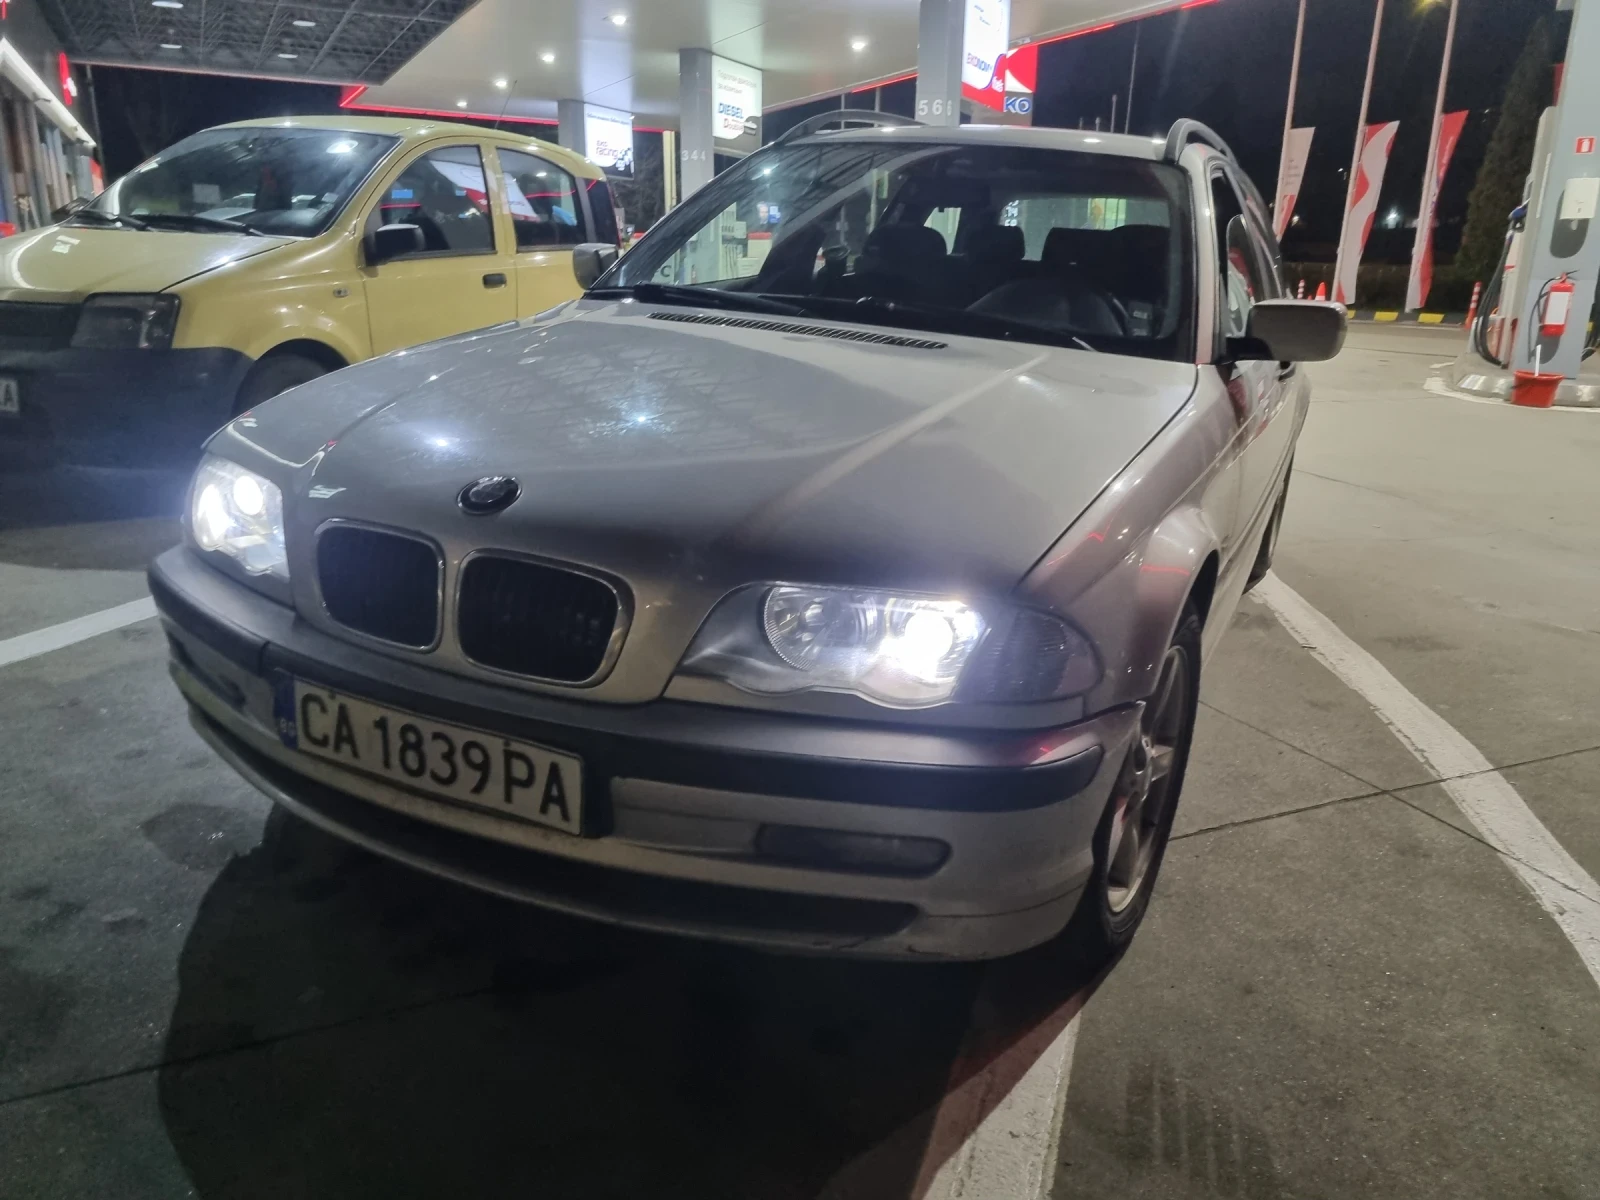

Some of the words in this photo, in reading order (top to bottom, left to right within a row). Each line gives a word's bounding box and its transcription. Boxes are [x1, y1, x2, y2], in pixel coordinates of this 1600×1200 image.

[718, 102, 745, 119] DIESEL
[1003, 96, 1032, 115] KO
[301, 693, 360, 760] CA
[373, 715, 491, 794] 1839
[503, 747, 571, 822] PA
